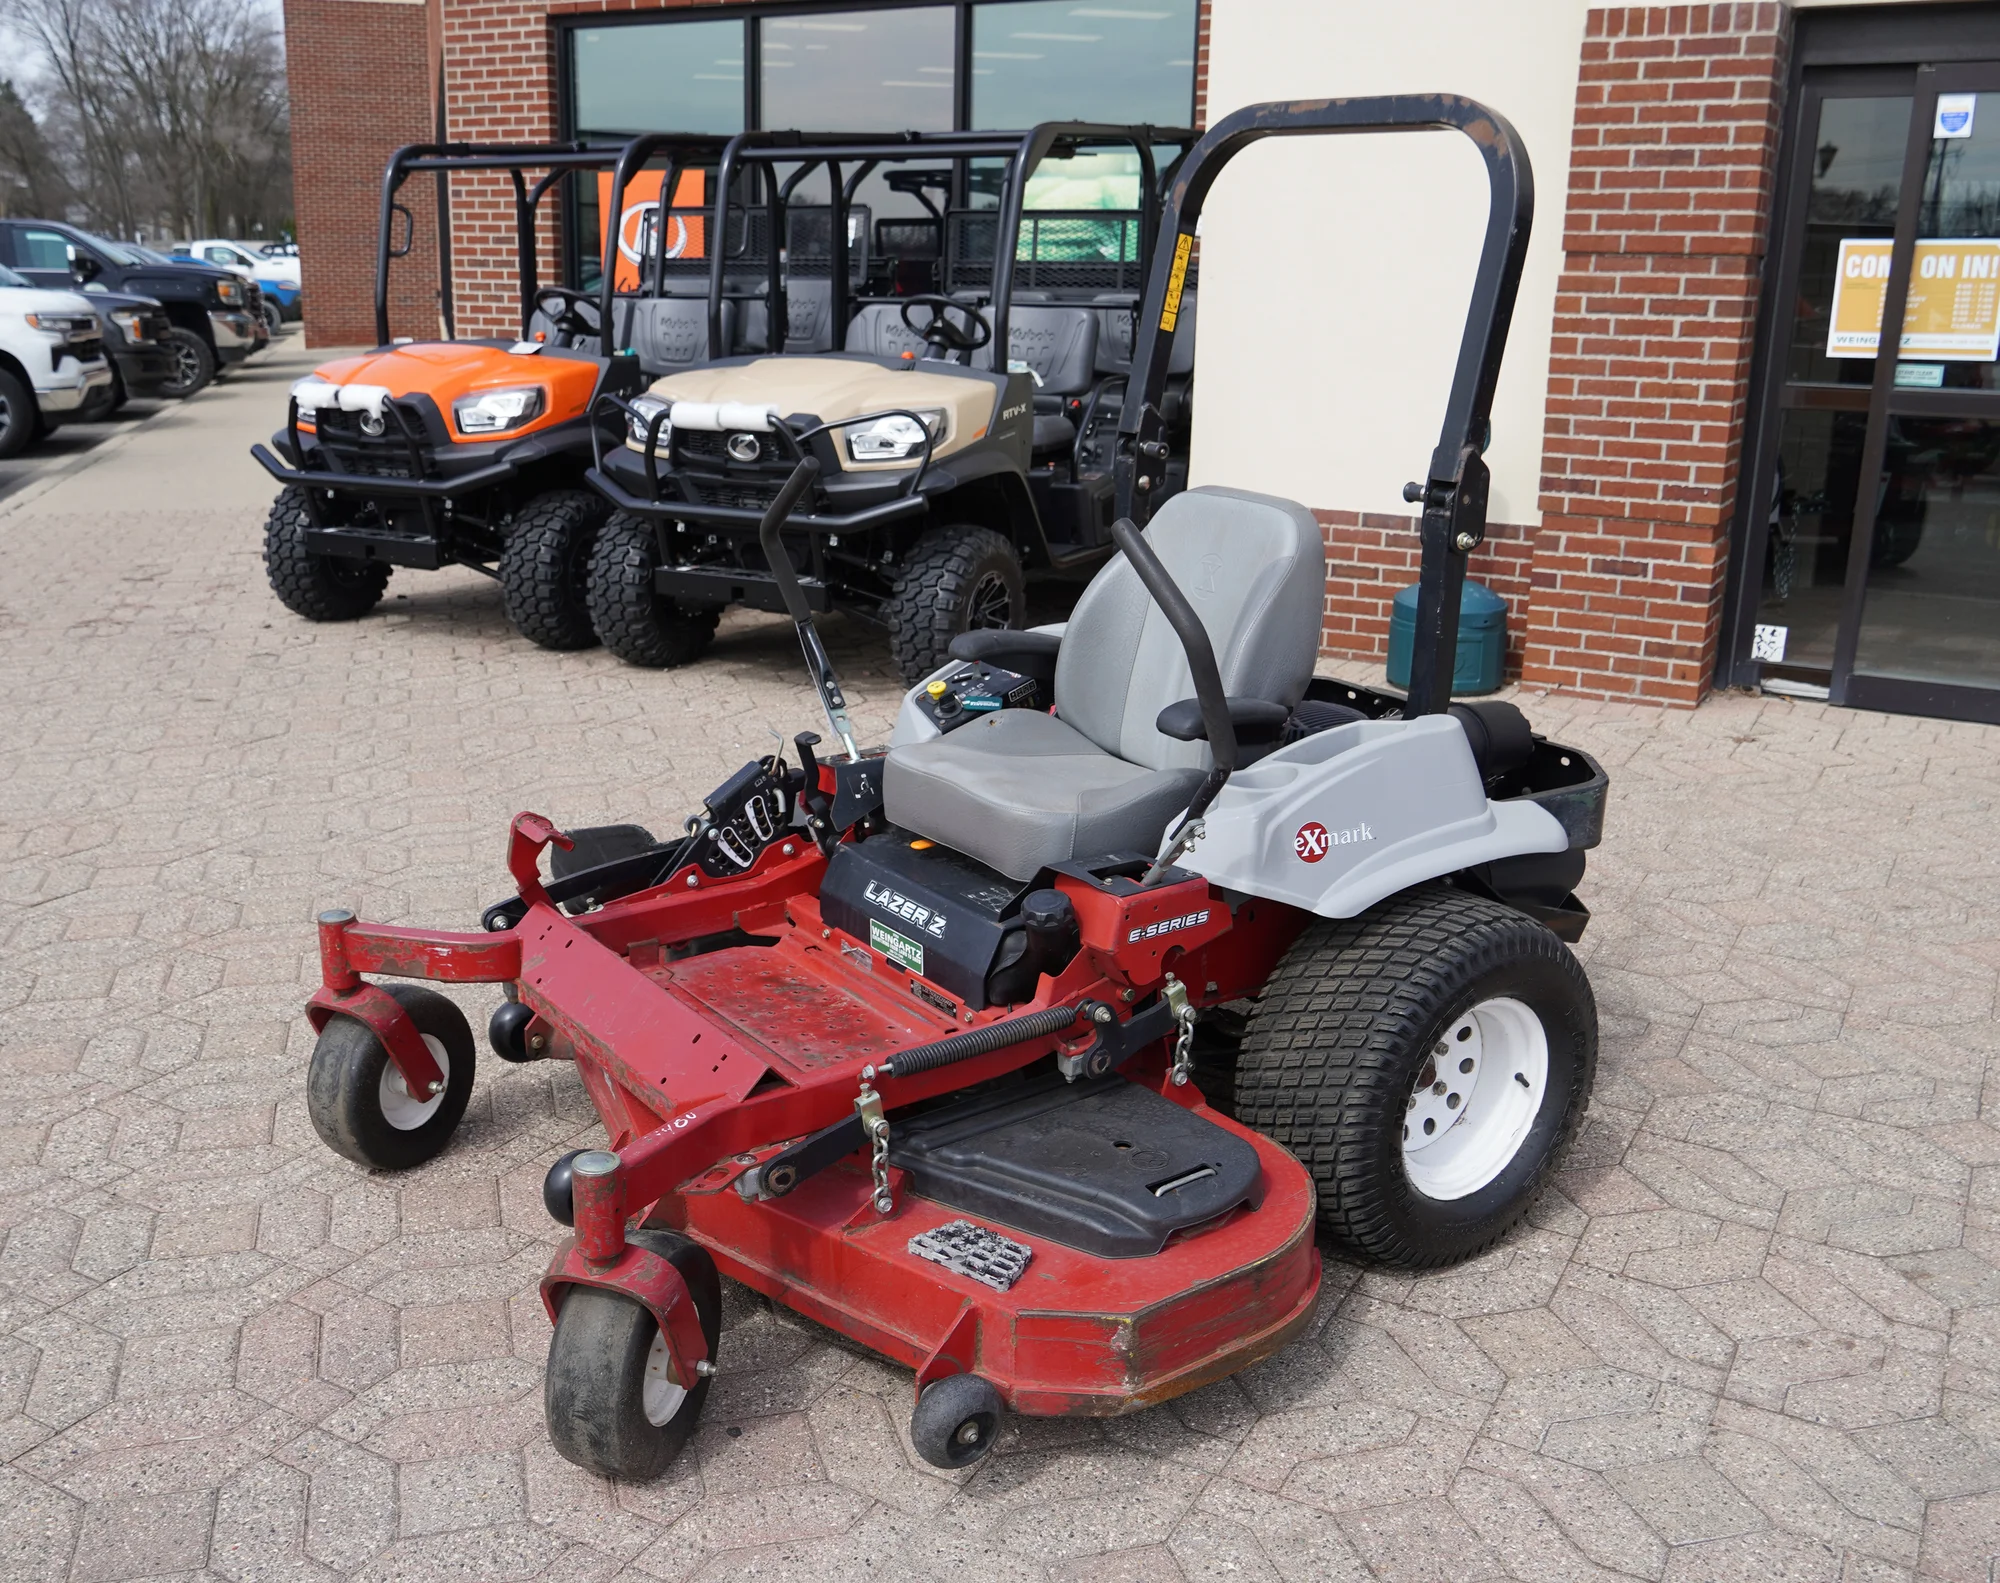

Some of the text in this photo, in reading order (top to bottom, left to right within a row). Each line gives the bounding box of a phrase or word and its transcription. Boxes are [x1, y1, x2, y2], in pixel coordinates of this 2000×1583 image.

[1845, 254, 2000, 278] COM ON IN!
[1003, 402, 1026, 420] RTV-X
[864, 881, 947, 936] LAZER Z
[871, 925, 922, 960] WEINGARTZ
[1128, 909, 1210, 943] E-SERIES
